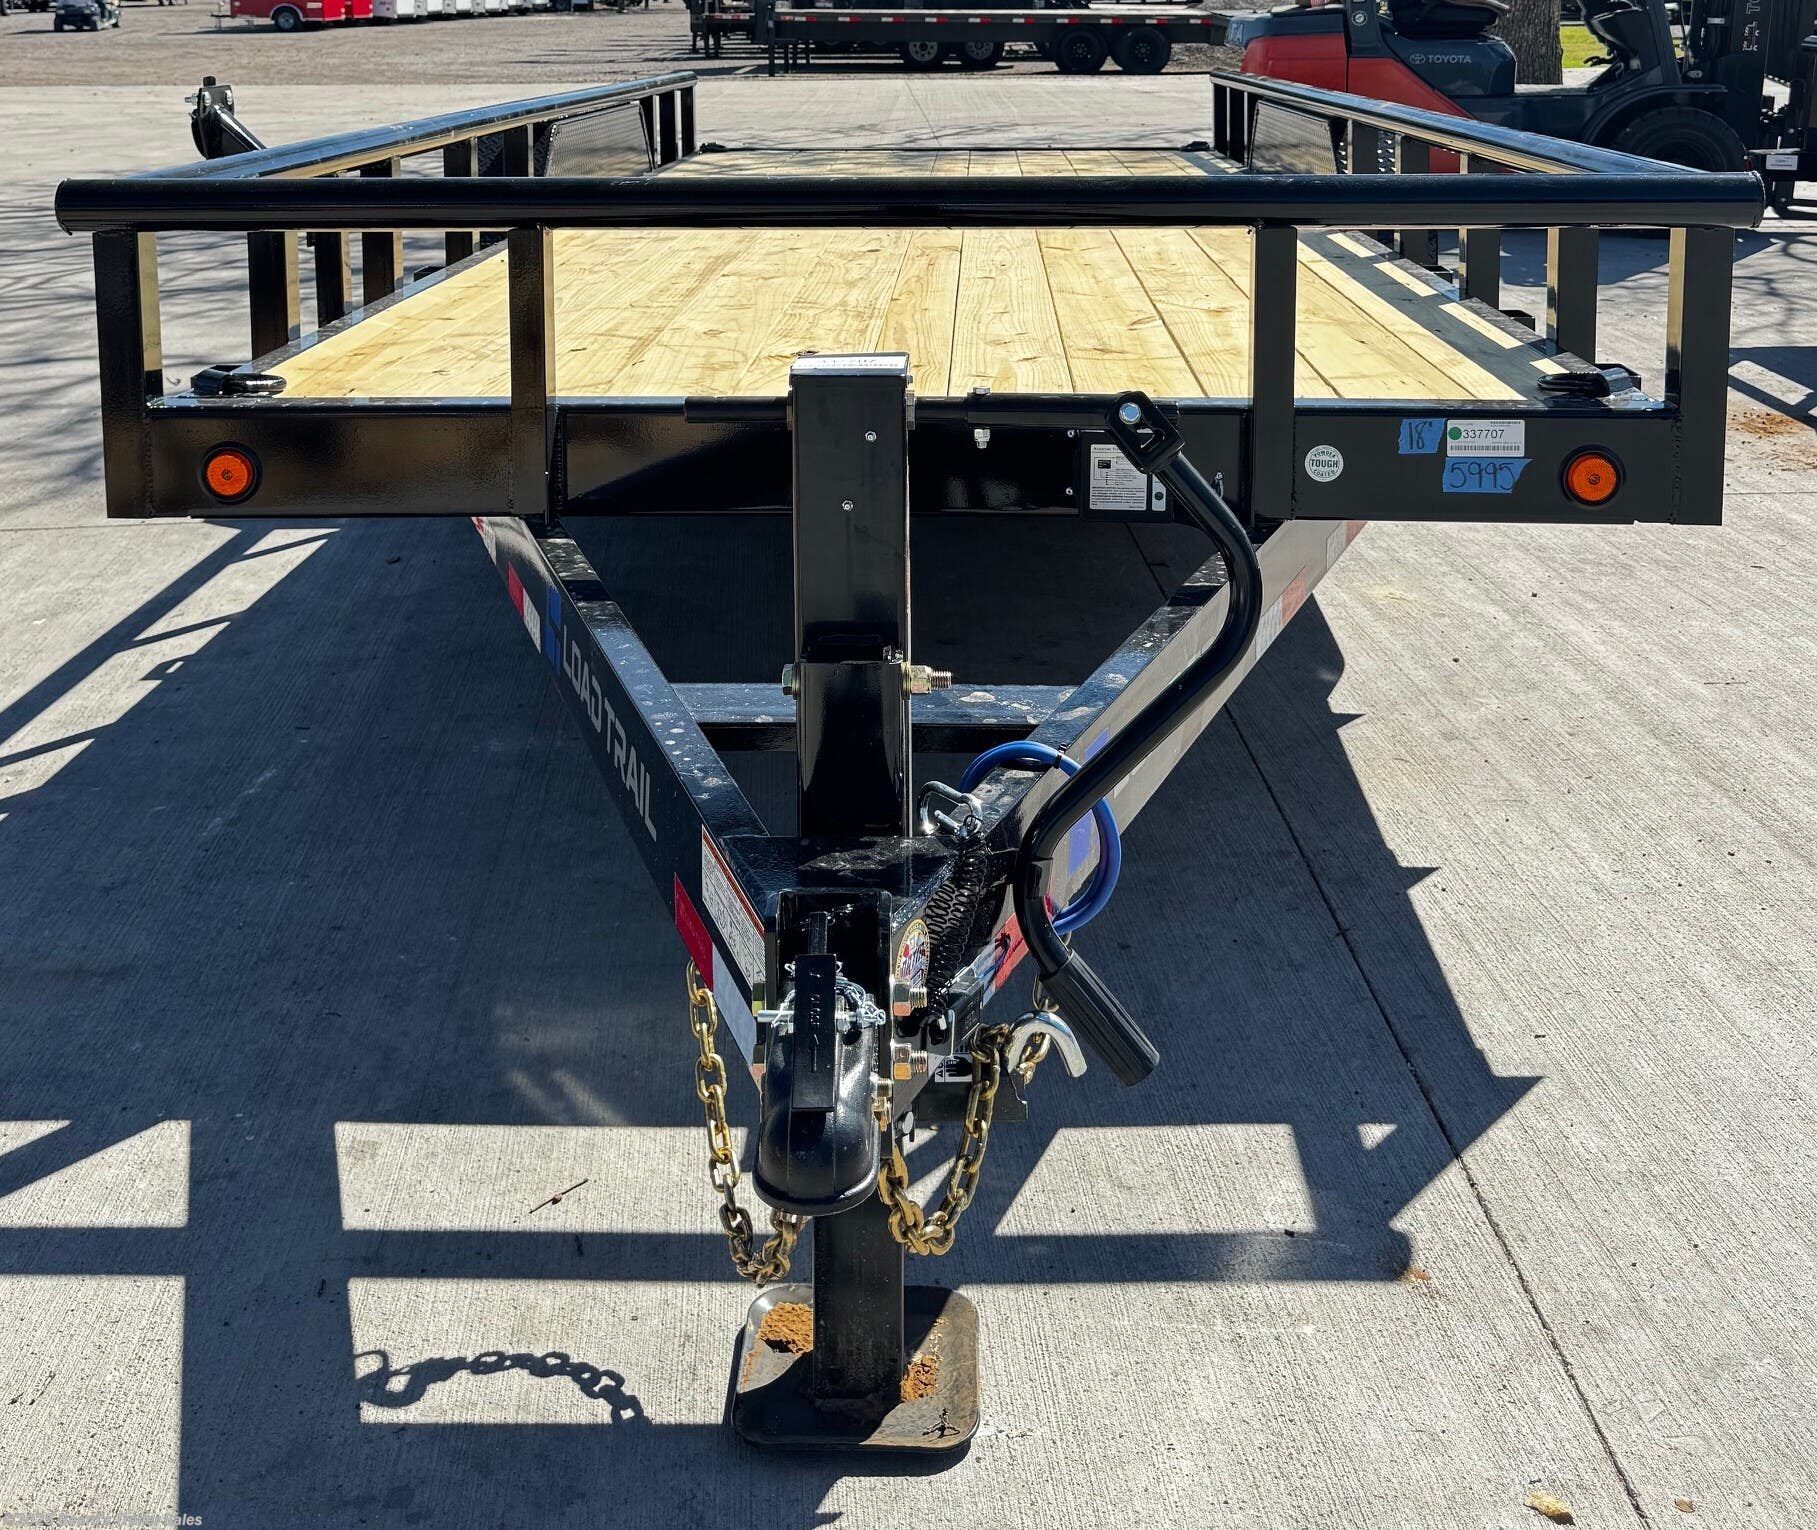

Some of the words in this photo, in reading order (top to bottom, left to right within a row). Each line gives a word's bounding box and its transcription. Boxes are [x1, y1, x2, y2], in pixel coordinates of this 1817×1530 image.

[1427, 54, 1472, 64] TOYOTA
[1462, 429, 1505, 439] 337707
[1310, 459, 1339, 469] TOUGH
[1449, 461, 1516, 491] 5995
